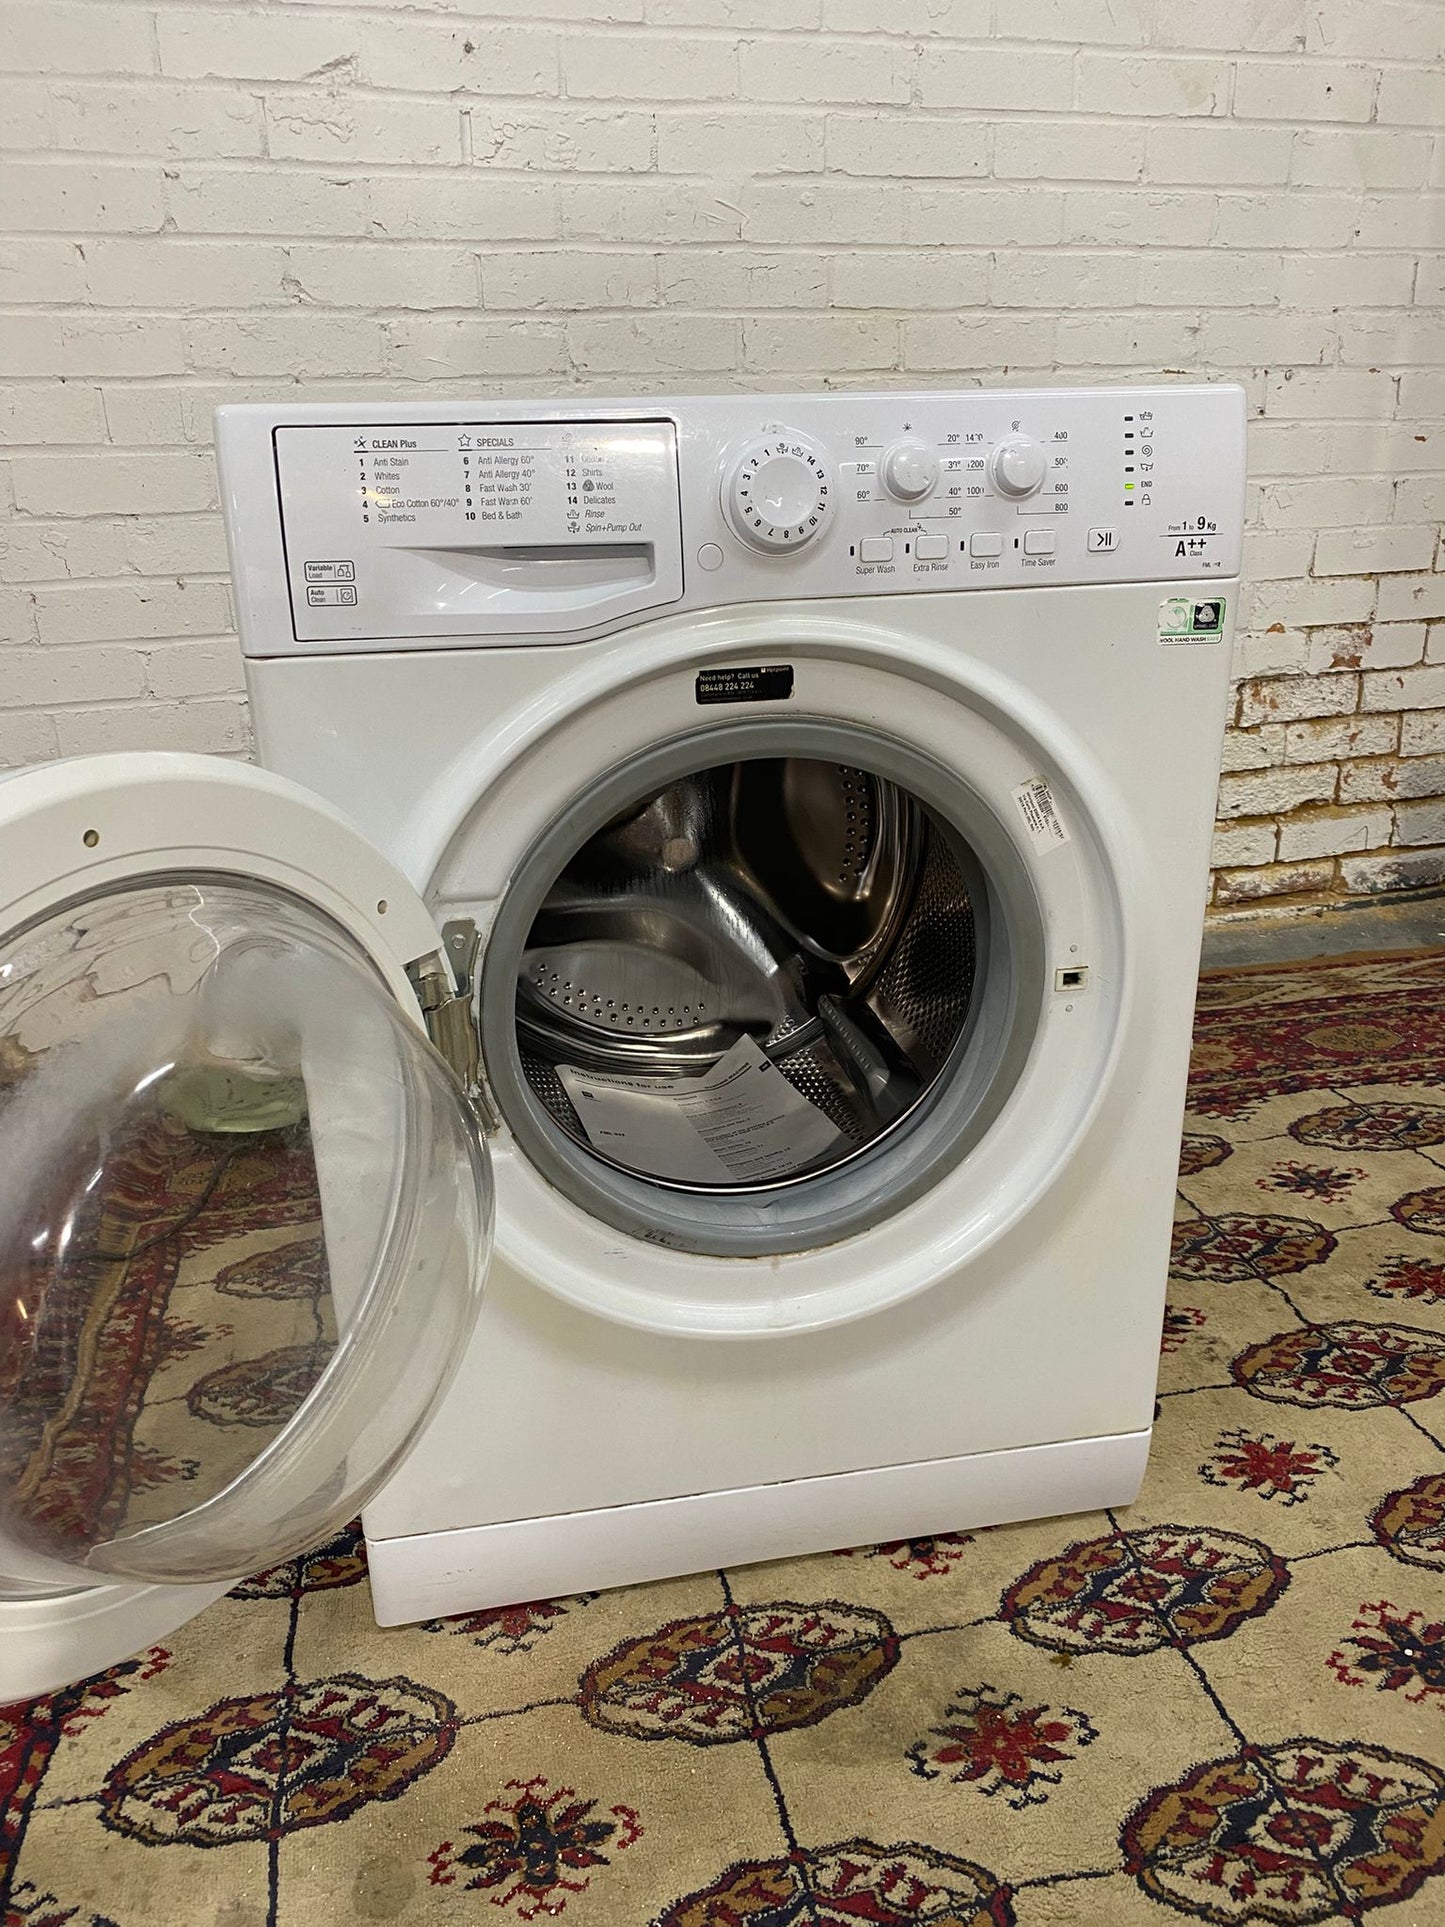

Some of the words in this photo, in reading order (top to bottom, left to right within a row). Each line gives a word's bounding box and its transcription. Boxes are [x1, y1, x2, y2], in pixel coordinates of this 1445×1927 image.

[947, 433, 960, 442] 20°
[1054, 431, 1068, 439] 400
[372, 440, 398, 449] CLEAN
[400, 439, 417, 448] Plus
[476, 438, 514, 447] SPECIALS
[855, 436, 868, 445] 90°
[764, 448, 770, 457] 1
[373, 458, 389, 467] Anti
[390, 457, 409, 466] Stain
[463, 457, 469, 465] 6
[478, 456, 492, 465] Anti
[494, 456, 519, 466] Allergy
[751, 458, 759, 466] 2
[806, 455, 816, 466] 14
[566, 469, 576, 477] 12
[581, 468, 603, 477] Shirts
[856, 464, 869, 472] 70°
[360, 472, 366, 481] 2
[374, 472, 401, 481] Whites
[464, 471, 470, 479] 7
[478, 470, 493, 479] Anti
[495, 470, 520, 480] Allergy
[816, 469, 825, 479] 13
[465, 484, 471, 492] 8
[479, 484, 496, 492] Fast
[497, 483, 518, 492] Wash
[566, 482, 577, 491] 13
[596, 482, 614, 490] Wool
[1055, 484, 1068, 492] 600
[1141, 480, 1153, 488] END
[361, 486, 367, 495] 3
[375, 485, 400, 494] Cotton
[820, 485, 828, 496] 12
[857, 490, 870, 499] 60°
[949, 487, 961, 495] 40°
[362, 500, 368, 509] 4
[392, 499, 405, 508] Eco
[406, 499, 429, 508] Cotton
[466, 498, 472, 506] 9
[480, 497, 496, 506] Fast
[498, 497, 519, 506] Wash
[567, 496, 578, 504] 14
[584, 496, 616, 505] Delicates
[744, 506, 753, 514] 5
[817, 502, 826, 511] 11
[949, 507, 962, 515] 50°
[1055, 503, 1068, 511] 800
[363, 514, 369, 523] 5
[378, 513, 416, 523] Synthetics
[465, 512, 476, 521] 10
[482, 511, 496, 520] Bed
[498, 511, 504, 520] &
[585, 510, 605, 518] Rinse
[808, 516, 818, 526] 10
[1197, 516, 1206, 530] 9
[1207, 521, 1217, 531] Kg
[585, 523, 629, 534] Spin+Pump
[629, 523, 642, 532] Out
[768, 528, 775, 536] 7
[783, 530, 790, 539] 8
[970, 562, 985, 570] Easy
[1021, 559, 1037, 567] Time
[1038, 558, 1056, 567] Saver
[855, 566, 875, 575] Super
[877, 565, 896, 573] Wash
[913, 564, 929, 572] Extra
[931, 563, 948, 571] Rinse
[700, 674, 716, 682] Need
[717, 673, 735, 681] help?
[700, 683, 723, 692] 08448
[725, 682, 739, 690] 224
[740, 681, 754, 690] 224
[570, 1069, 634, 1087] Instructions
